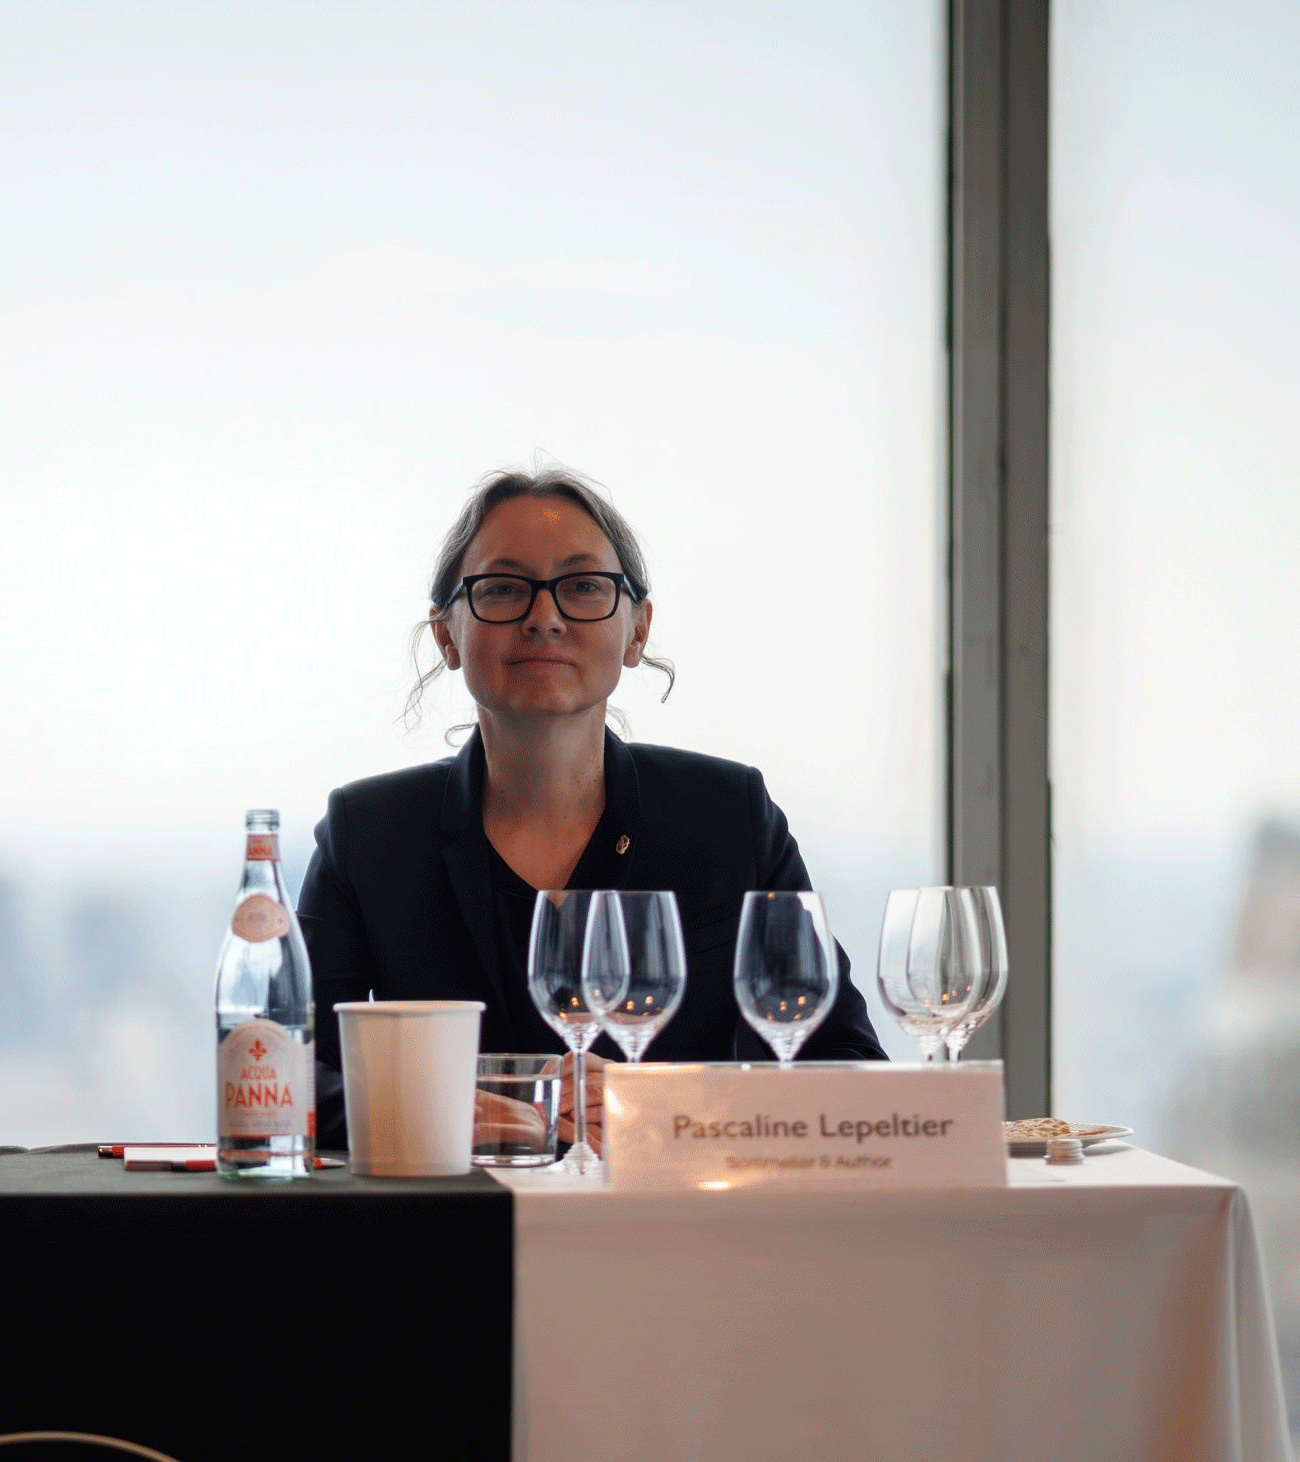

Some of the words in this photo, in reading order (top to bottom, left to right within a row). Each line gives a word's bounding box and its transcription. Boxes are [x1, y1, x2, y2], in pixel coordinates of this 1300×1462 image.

[240, 1066, 278, 1080] ACQUA
[224, 1081, 294, 1108] PANNA
[673, 1113, 808, 1139] Pascaline
[819, 1112, 954, 1143] Lepeltier
[834, 1154, 893, 1170] Author
